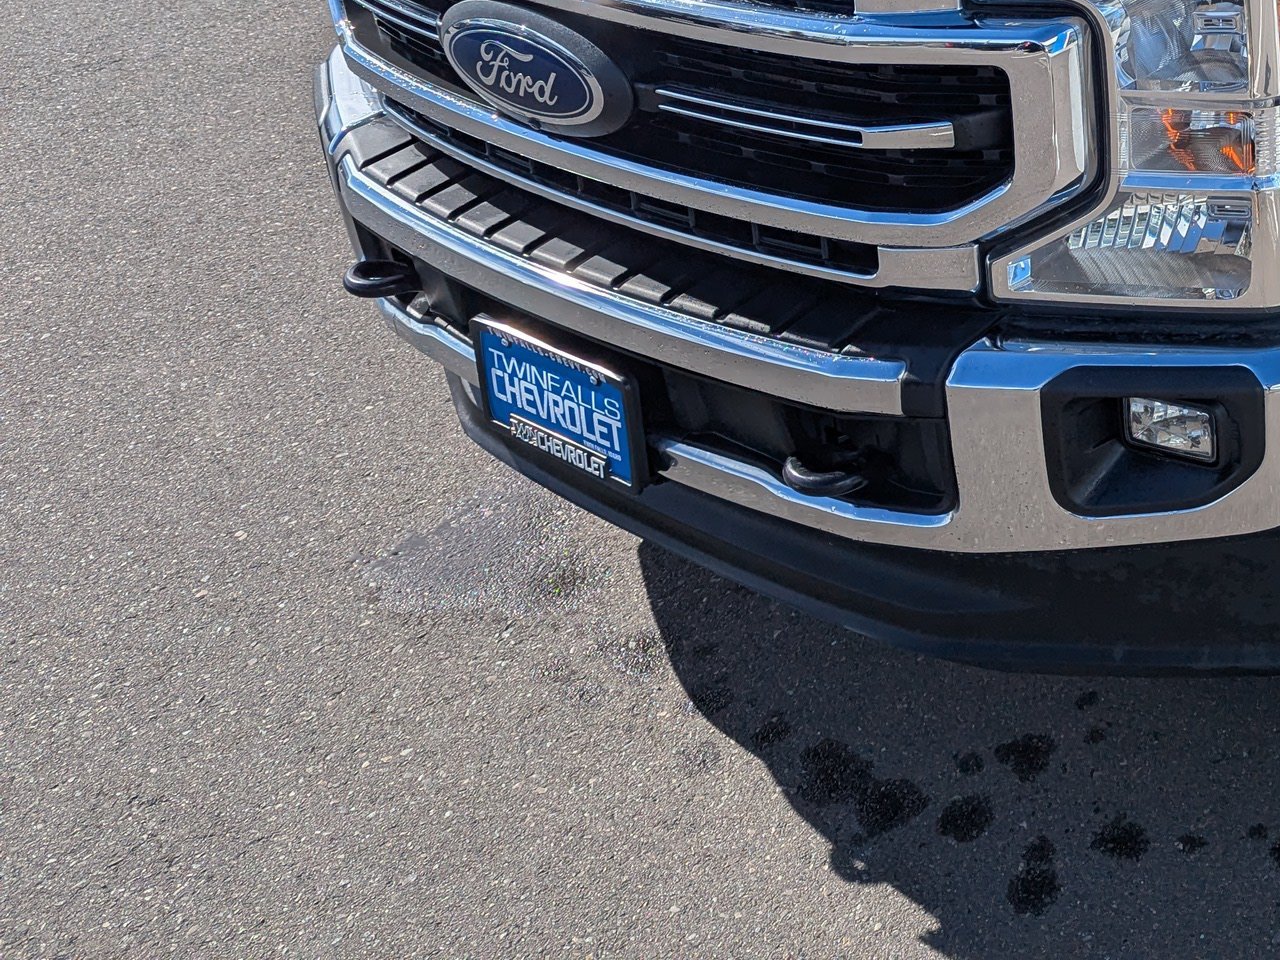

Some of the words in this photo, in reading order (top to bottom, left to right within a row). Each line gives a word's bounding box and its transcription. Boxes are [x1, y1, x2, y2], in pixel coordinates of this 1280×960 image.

[476, 39, 558, 106] Ford
[491, 367, 622, 452] CHEVROLET
[537, 431, 606, 479] CHEVROLET
